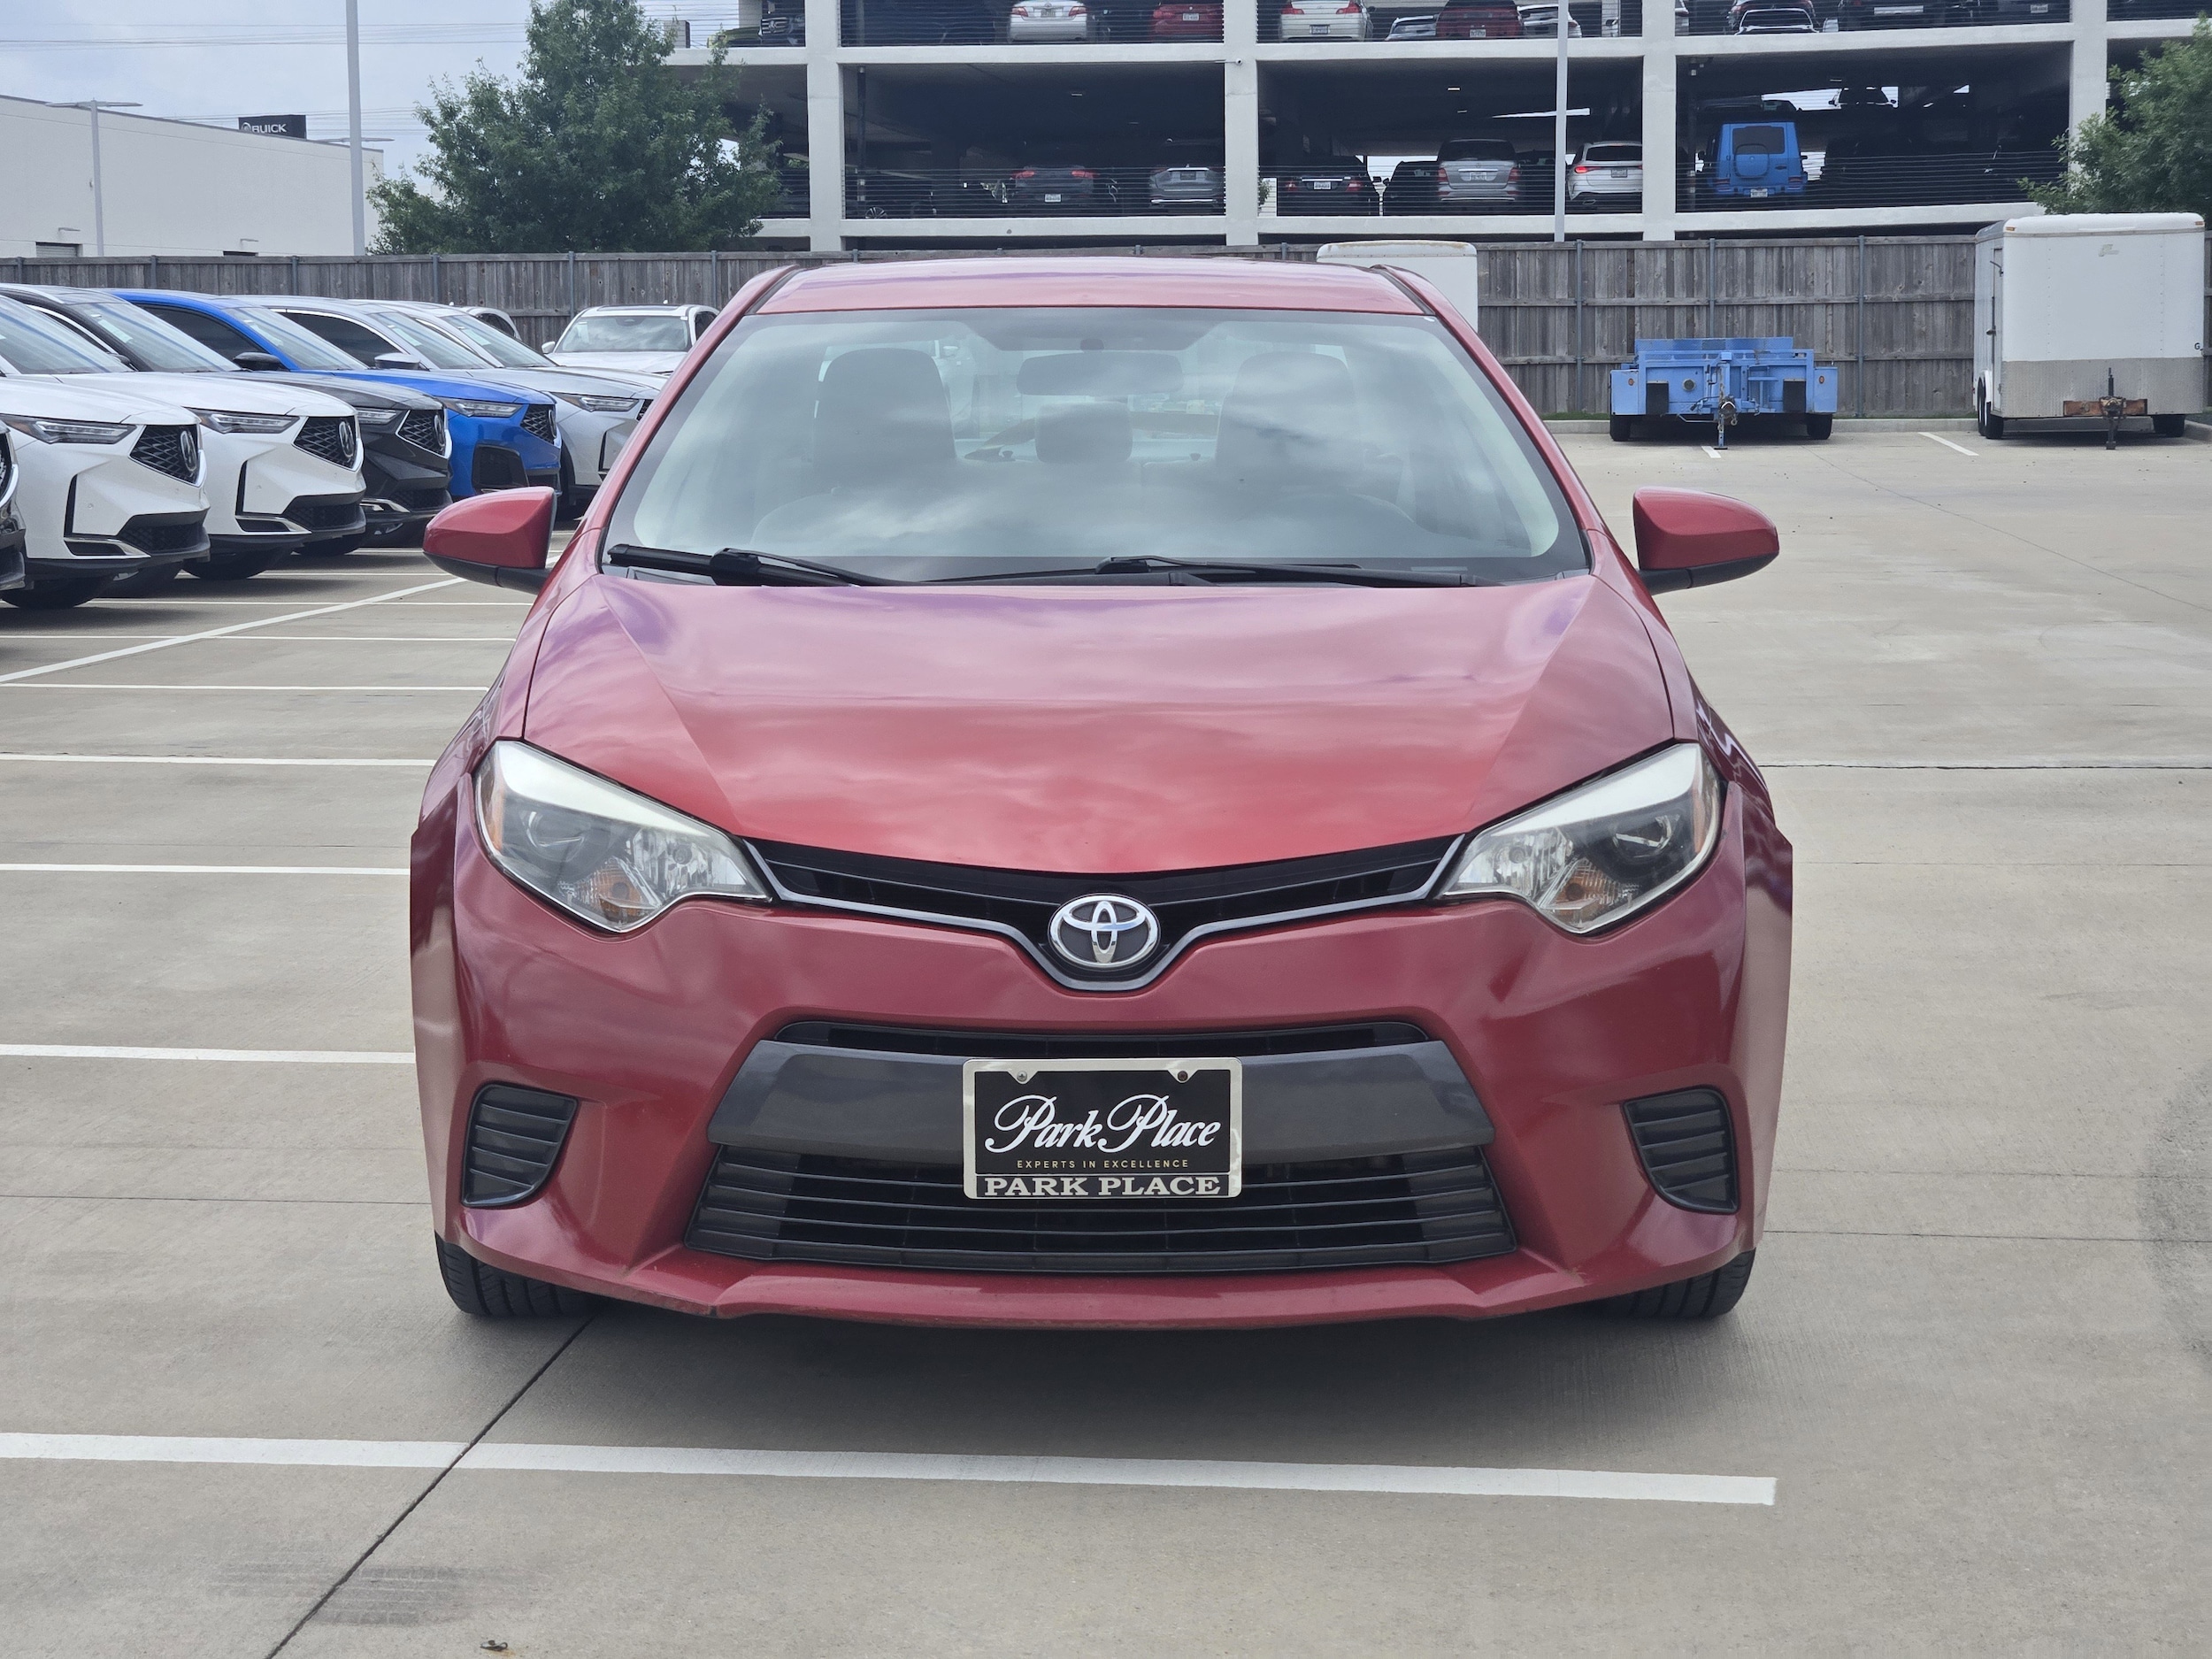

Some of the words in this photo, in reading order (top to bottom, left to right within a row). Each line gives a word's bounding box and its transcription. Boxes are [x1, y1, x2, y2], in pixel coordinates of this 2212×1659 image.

[251, 123, 288, 134] BUICK
[985, 1094, 1102, 1153] Park
[1097, 1094, 1221, 1153] Place
[1017, 1159, 1076, 1169] EXPERTS
[1082, 1159, 1096, 1169] IN
[1103, 1159, 1189, 1169] EXCELLENCE
[984, 1177, 1089, 1196] PARK
[1098, 1176, 1222, 1196] PLACE
